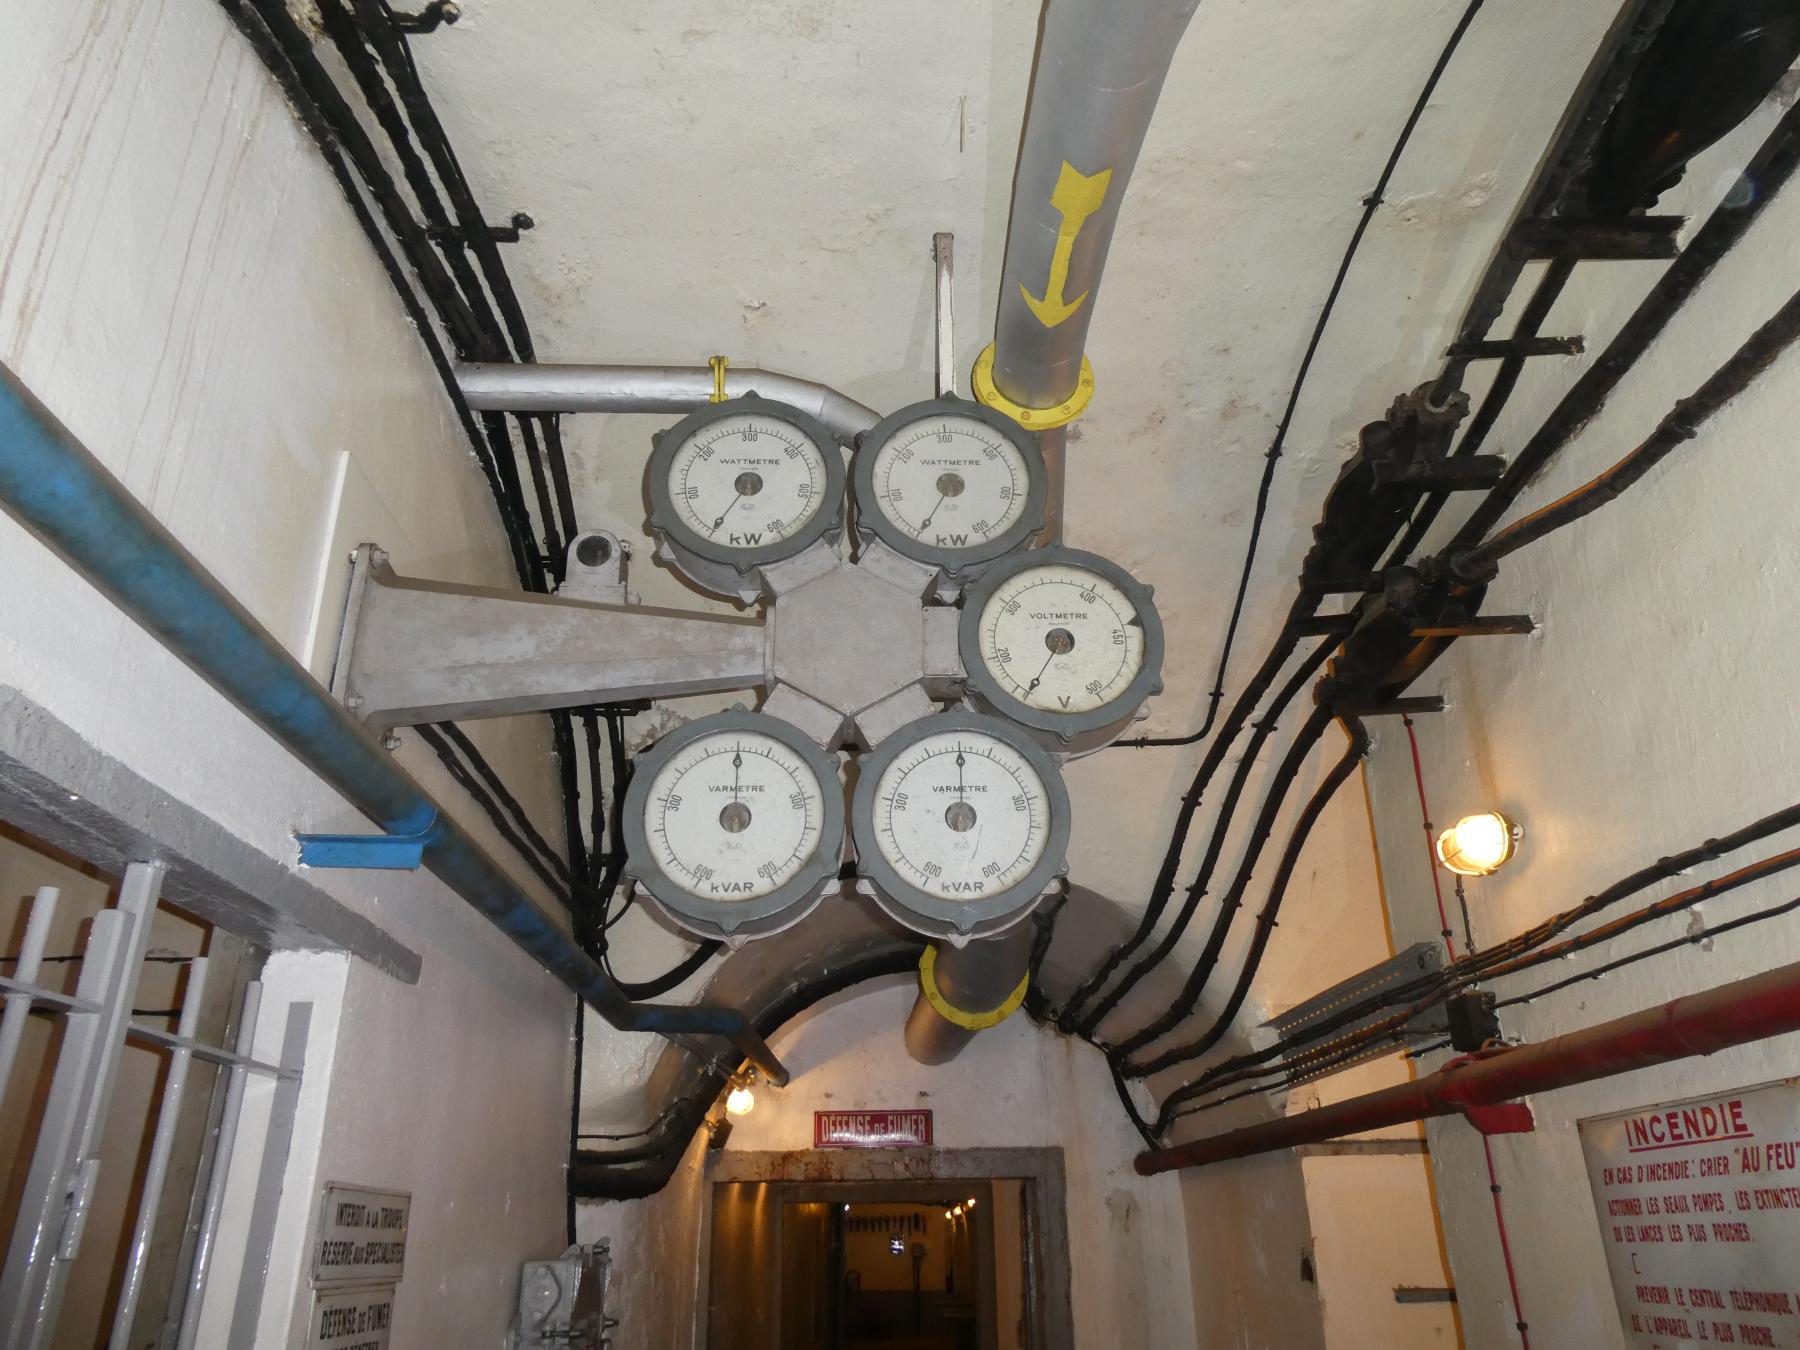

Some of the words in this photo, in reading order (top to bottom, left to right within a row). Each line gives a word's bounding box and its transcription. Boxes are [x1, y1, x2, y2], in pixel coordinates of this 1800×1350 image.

[742, 433, 758, 442] 300
[937, 434, 952, 443] 300
[699, 446, 715, 461] 200
[784, 446, 799, 460] 400
[898, 448, 915, 464] 200
[982, 447, 998, 461] 400
[688, 486, 699, 500] 100
[798, 483, 810, 499] 500
[890, 489, 903, 502] 100
[1000, 486, 1012, 500] 500
[767, 519, 784, 533] 600
[972, 519, 989, 534] 600
[730, 533, 762, 545] kW
[936, 534, 968, 546] kW
[1079, 591, 1096, 604] 400
[1005, 600, 1022, 616] 300
[1111, 629, 1124, 645] 450
[997, 648, 1012, 664] 200
[1085, 679, 1103, 694] 500
[1058, 696, 1070, 709] V
[708, 785, 765, 793] VARMETRE
[932, 785, 988, 793] VARMETRE
[668, 794, 683, 812] 300
[789, 792, 804, 810] 300
[894, 792, 909, 811] 300
[1012, 794, 1027, 812] 300
[694, 864, 714, 880] 600
[757, 861, 777, 879] 600
[923, 861, 942, 878] 600
[982, 862, 1001, 878] 600
[711, 882, 754, 893] kVAR
[941, 881, 985, 893] kVAR
[887, 1114, 926, 1142] FUMER
[1624, 1100, 1748, 1147] INCENDIE
[1604, 1168, 1614, 1186] EN
[1617, 1166, 1632, 1185] CAS
[1700, 1156, 1730, 1177] CRIER
[1608, 1198, 1643, 1216] ACTIONNER
[1645, 1196, 1660, 1215] LES
[1663, 1194, 1690, 1214] SEAUX
[1734, 1190, 1752, 1210] LES
[1613, 1226, 1623, 1242] OU
[1623, 1225, 1636, 1242] LES
[1636, 1225, 1664, 1242] LANCES
[1667, 1224, 1683, 1242] LES
[1687, 1223, 1707, 1242] PLUS
[1674, 1287, 1686, 1306] LE
[1688, 1288, 1725, 1309] CENTRAL
[1697, 1320, 1708, 1341] LE
[1712, 1321, 1734, 1343] PLUS
